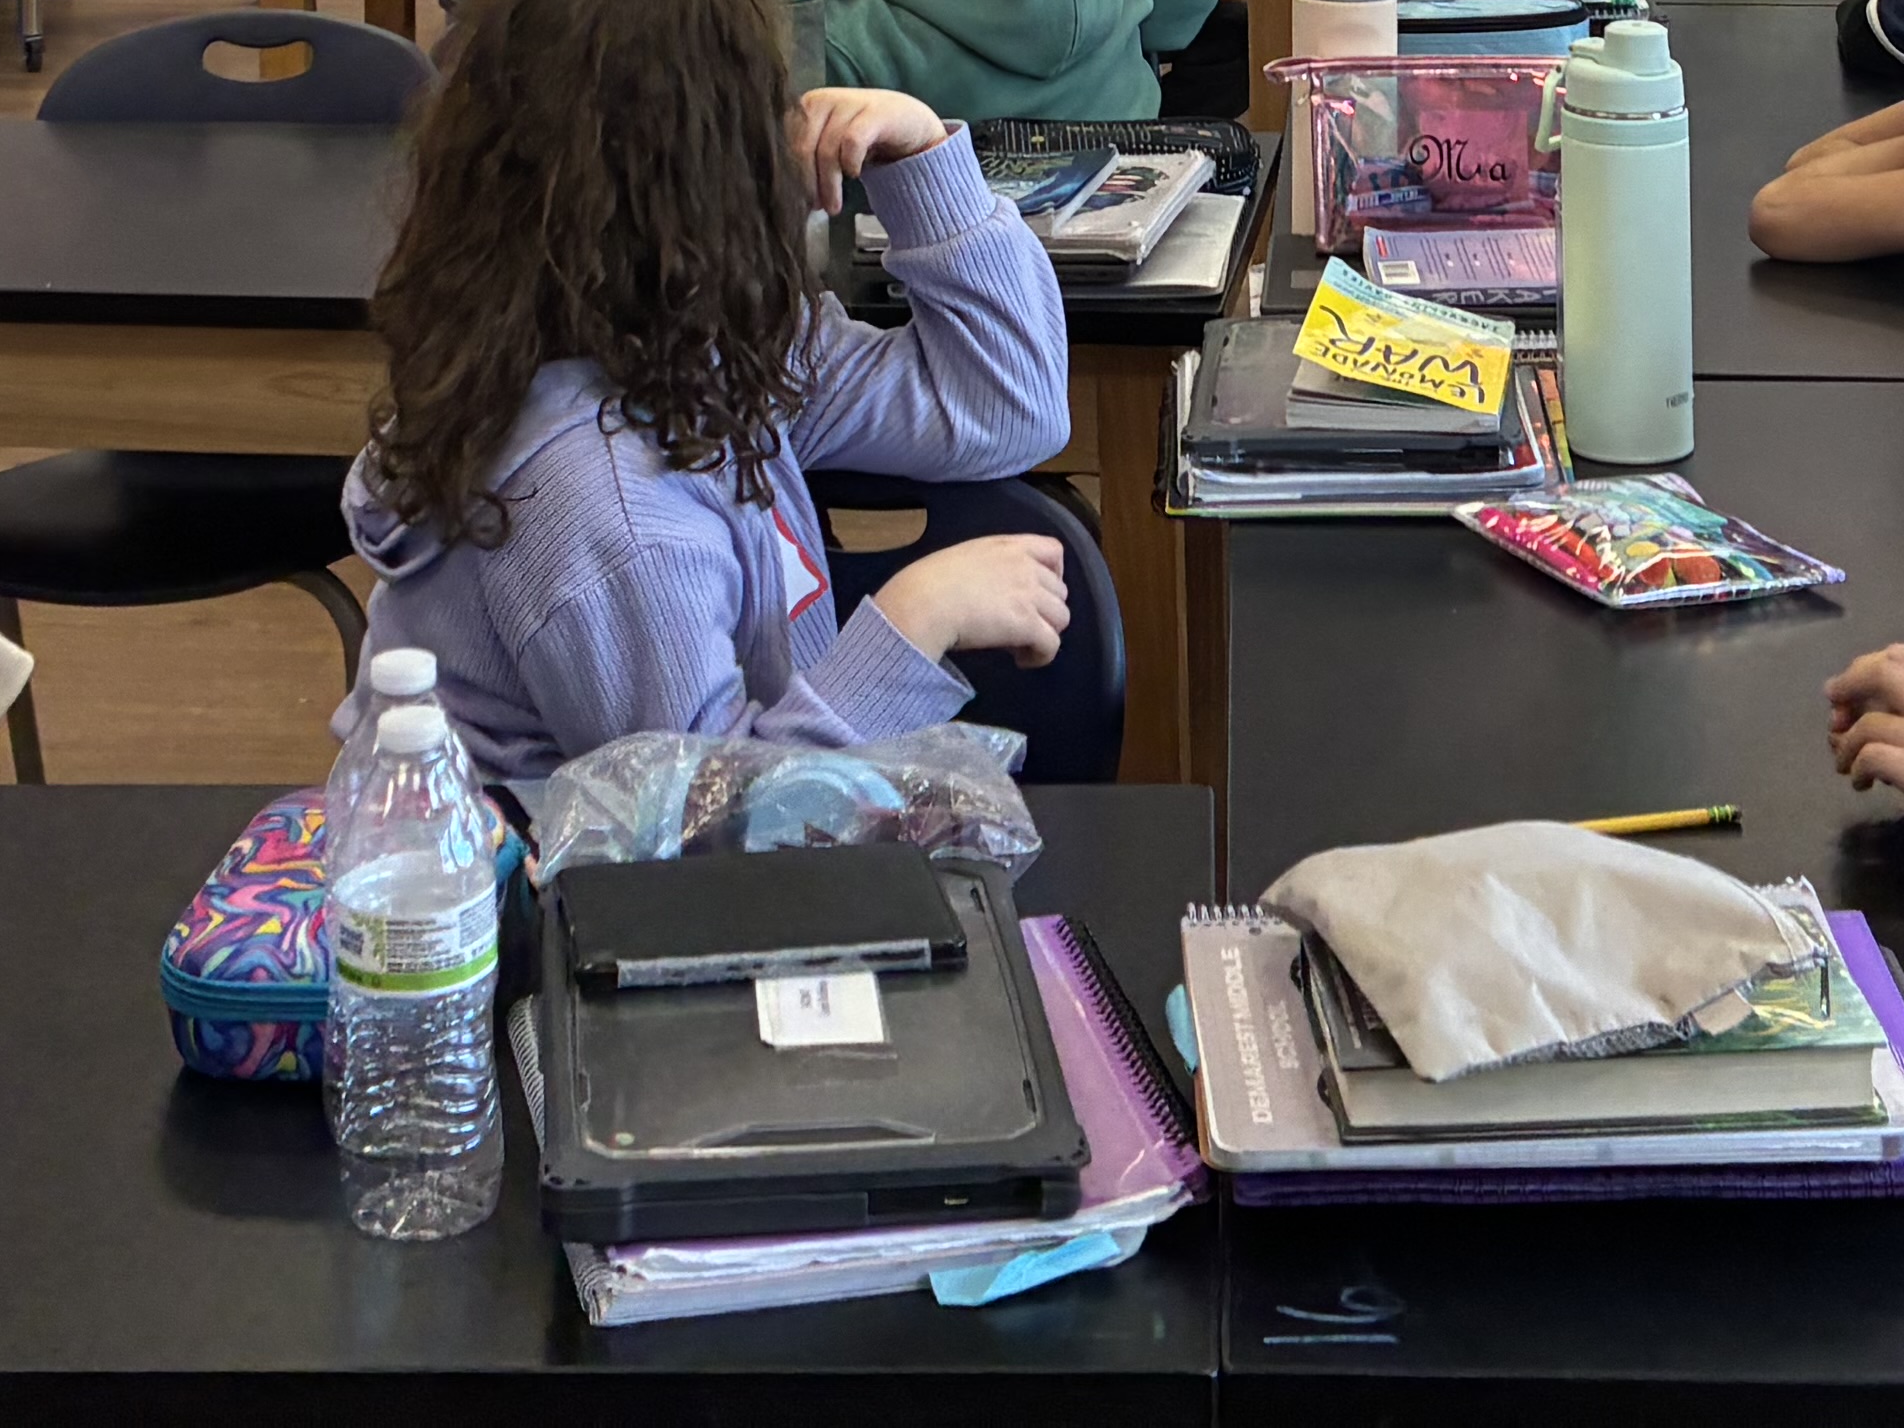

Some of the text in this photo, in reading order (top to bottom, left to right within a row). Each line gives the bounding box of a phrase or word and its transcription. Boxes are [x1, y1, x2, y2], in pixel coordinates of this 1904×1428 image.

[1315, 343, 1485, 404] LEMONADE
[1319, 304, 1480, 386] WAR
[1221, 947, 1273, 1124] DEMAREST MIDDLE
[1268, 1000, 1300, 1069] SCHOOL
